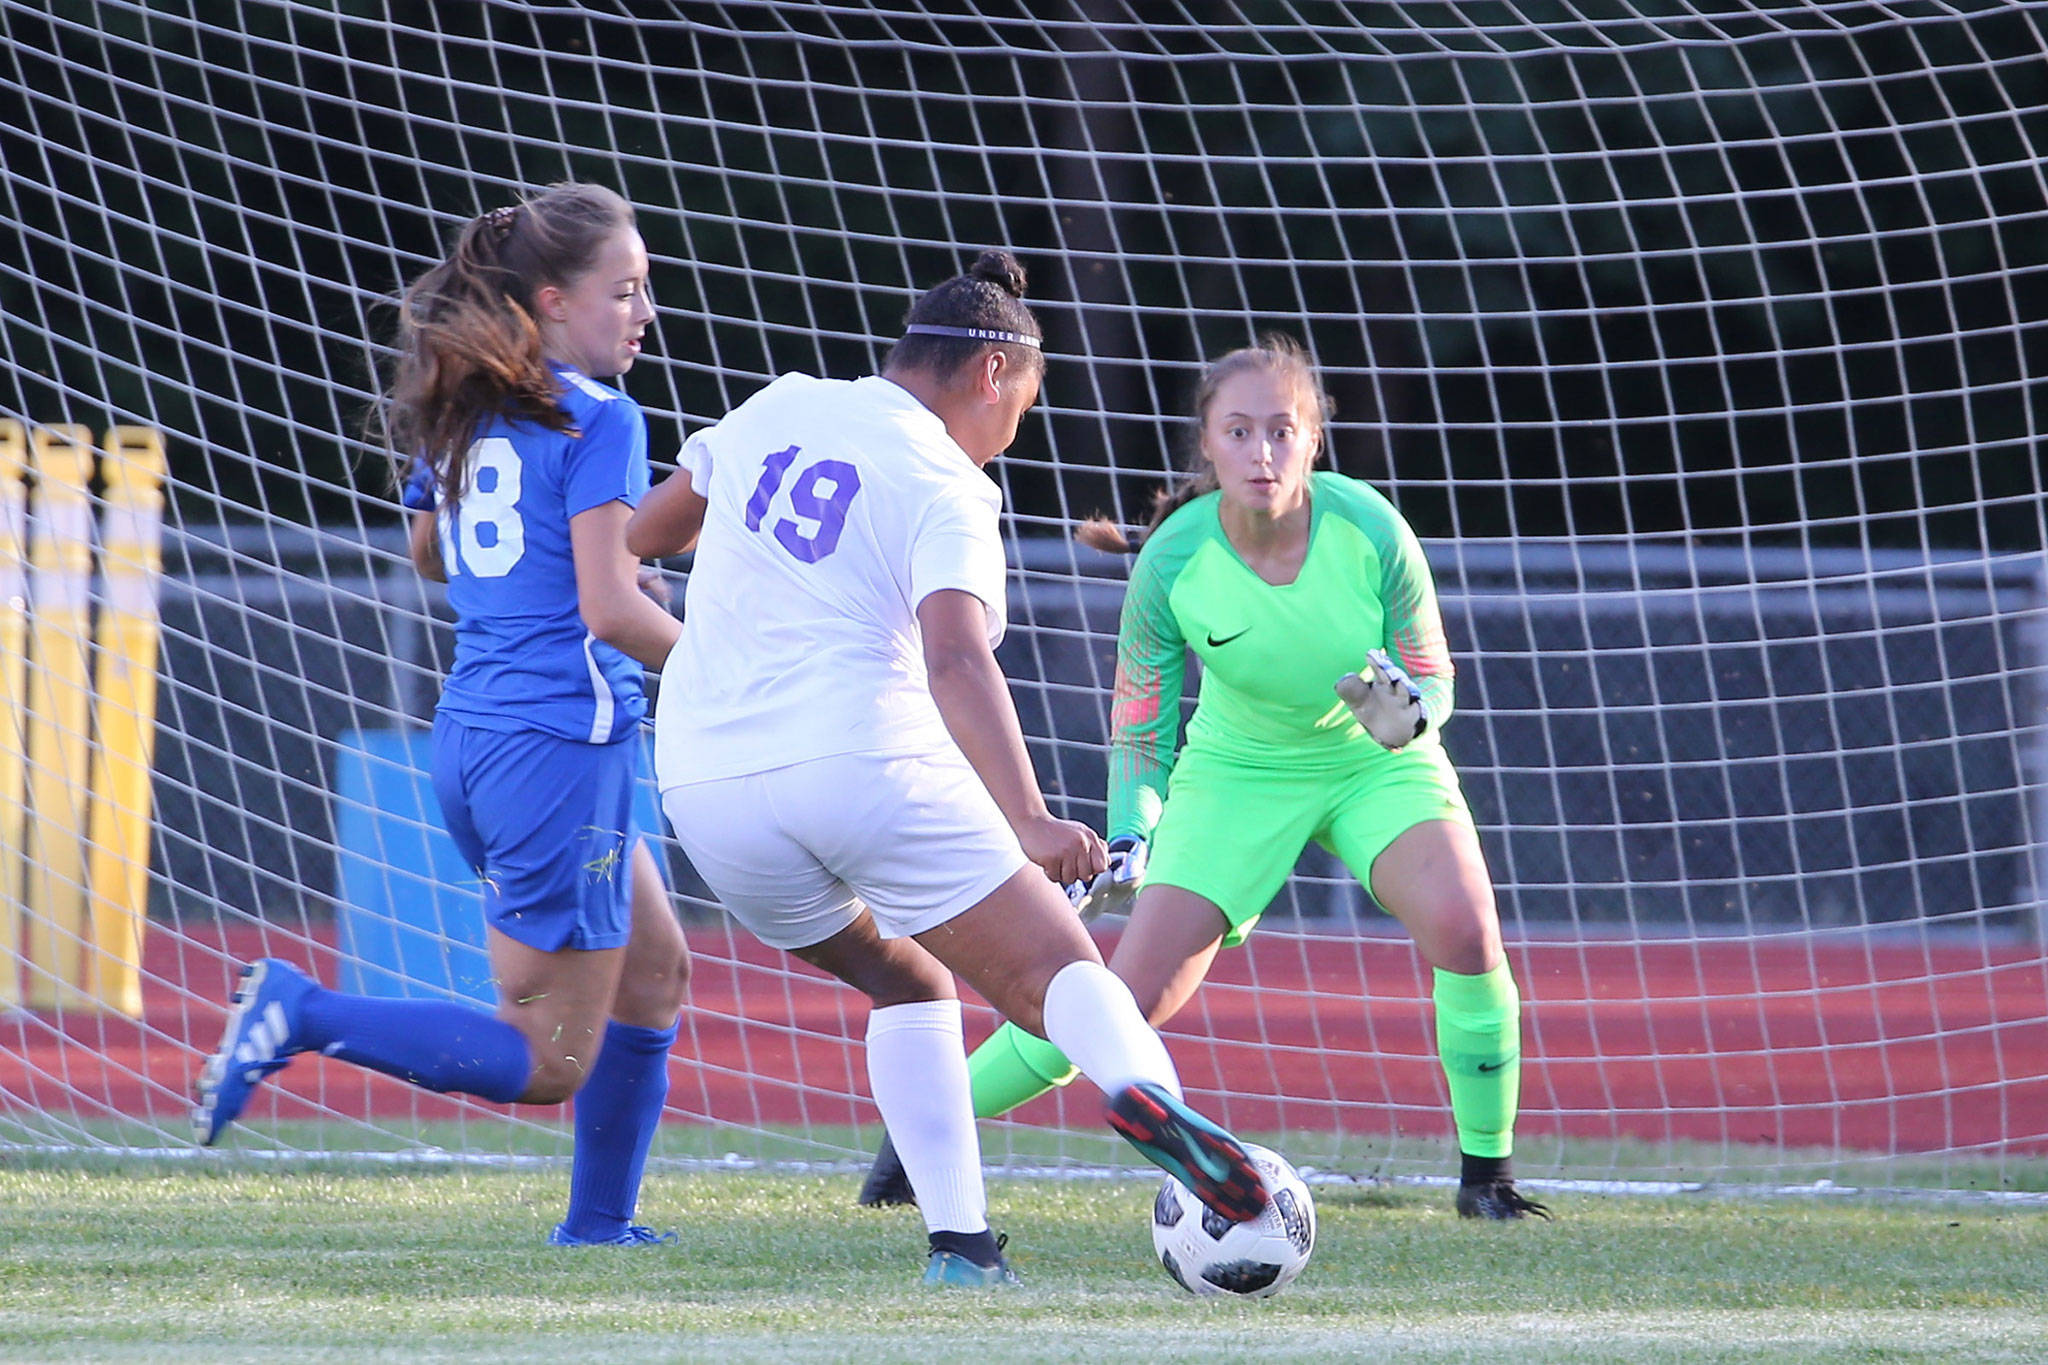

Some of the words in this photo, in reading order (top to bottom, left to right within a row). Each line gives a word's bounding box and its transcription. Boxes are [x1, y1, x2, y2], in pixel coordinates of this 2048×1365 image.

[968, 328, 1014, 341] UNDER
[434, 437, 526, 578] 18
[745, 444, 862, 565] 19
